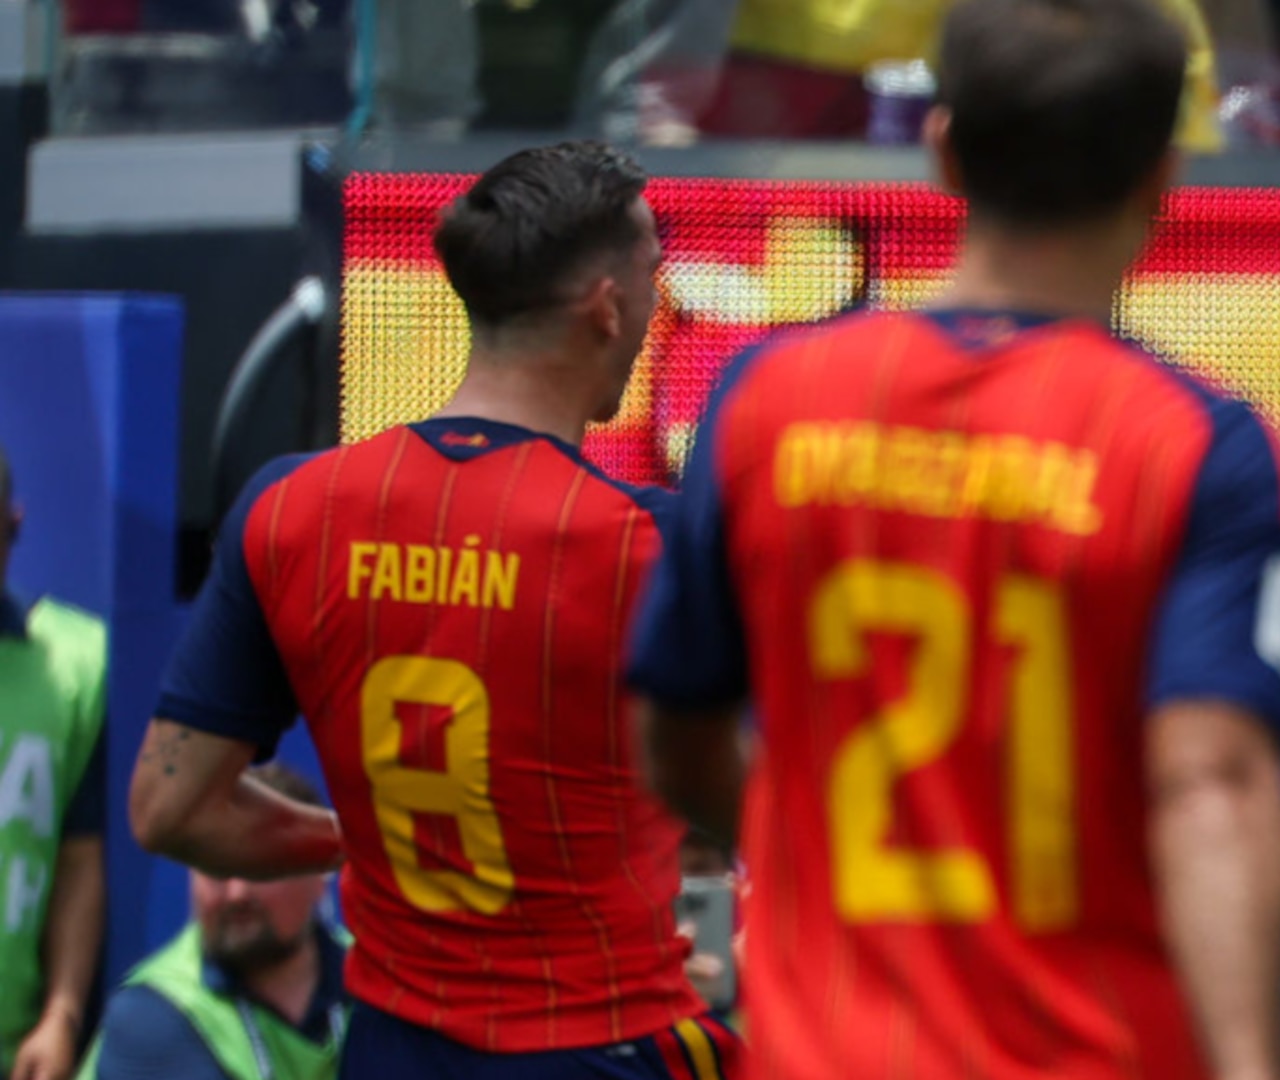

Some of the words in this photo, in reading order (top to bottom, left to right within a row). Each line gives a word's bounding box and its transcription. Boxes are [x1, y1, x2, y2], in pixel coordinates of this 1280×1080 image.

[347, 535, 521, 610] FABIÁN
[361, 654, 515, 915] 8
[806, 556, 1078, 938] 21
